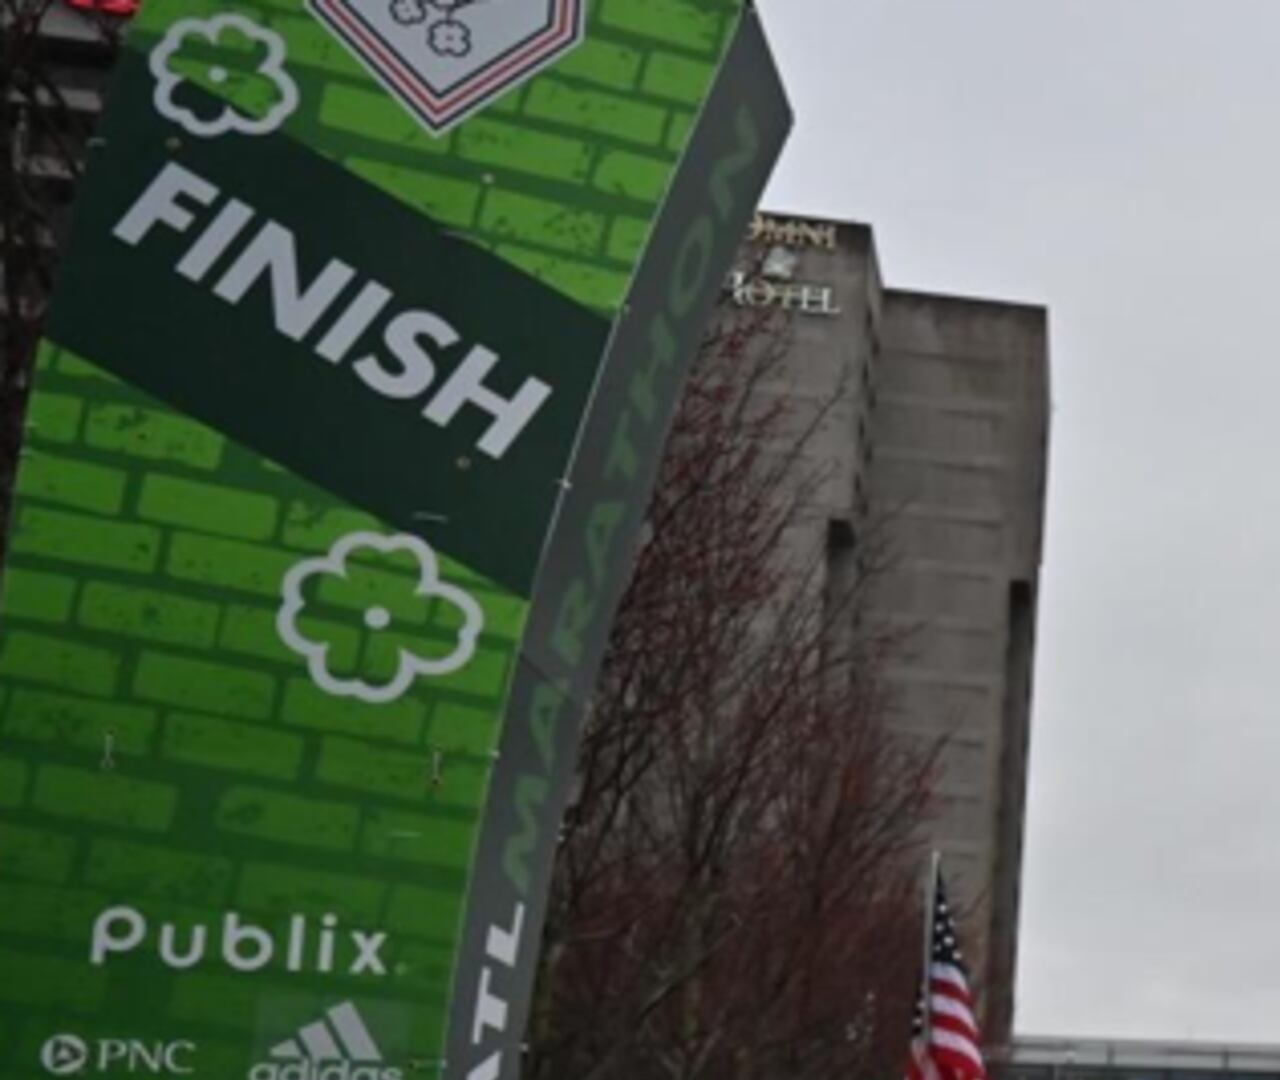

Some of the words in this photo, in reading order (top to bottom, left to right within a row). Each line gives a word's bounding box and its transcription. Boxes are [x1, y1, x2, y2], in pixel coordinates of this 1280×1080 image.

[112, 161, 552, 461] FINISH
[89, 905, 388, 976] Publix
[99, 1038, 197, 1074] PNC
